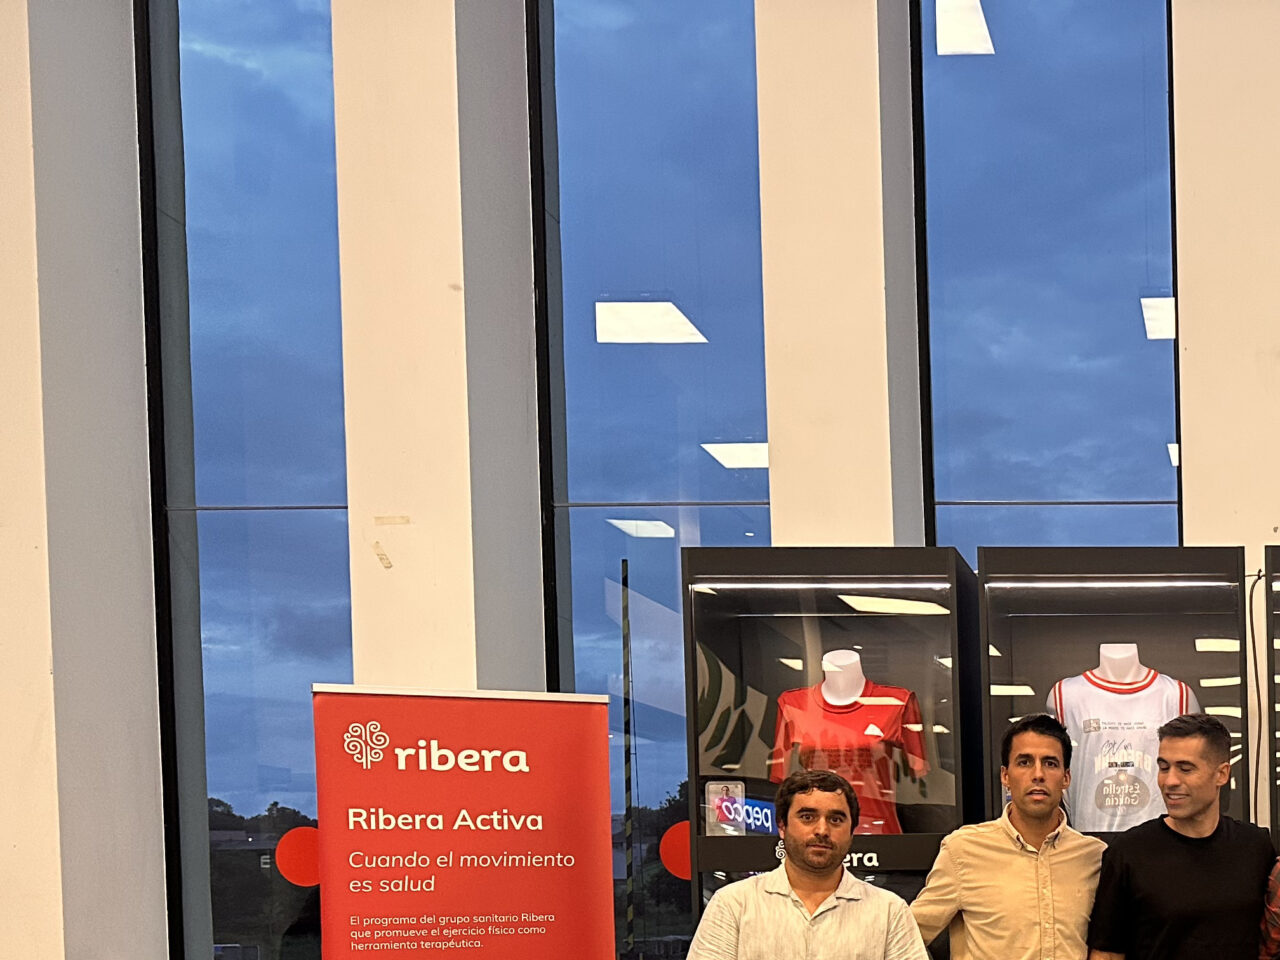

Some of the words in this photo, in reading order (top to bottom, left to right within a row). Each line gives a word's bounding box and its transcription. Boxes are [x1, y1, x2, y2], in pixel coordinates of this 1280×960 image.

[394, 739, 530, 773] ribera
[348, 807, 444, 831] Ribera
[453, 808, 543, 831] Activa
[349, 851, 430, 869] Cuando
[436, 850, 453, 868] el
[459, 851, 575, 868] movimiento
[349, 880, 373, 893] es
[379, 875, 435, 892] salud
[350, 915, 360, 926] El
[363, 917, 417, 928] programa
[419, 914, 436, 924] del
[438, 915, 471, 927] grupo
[472, 913, 519, 924] sanitario
[521, 912, 555, 922] Ribera
[350, 930, 372, 941] que
[374, 929, 428, 940] promueve
[430, 926, 440, 937] el
[442, 925, 486, 938] ejercicio
[488, 925, 515, 935] físico
[517, 926, 546, 935] como
[350, 940, 418, 951] herramienta
[420, 938, 484, 950] terapéutica.
